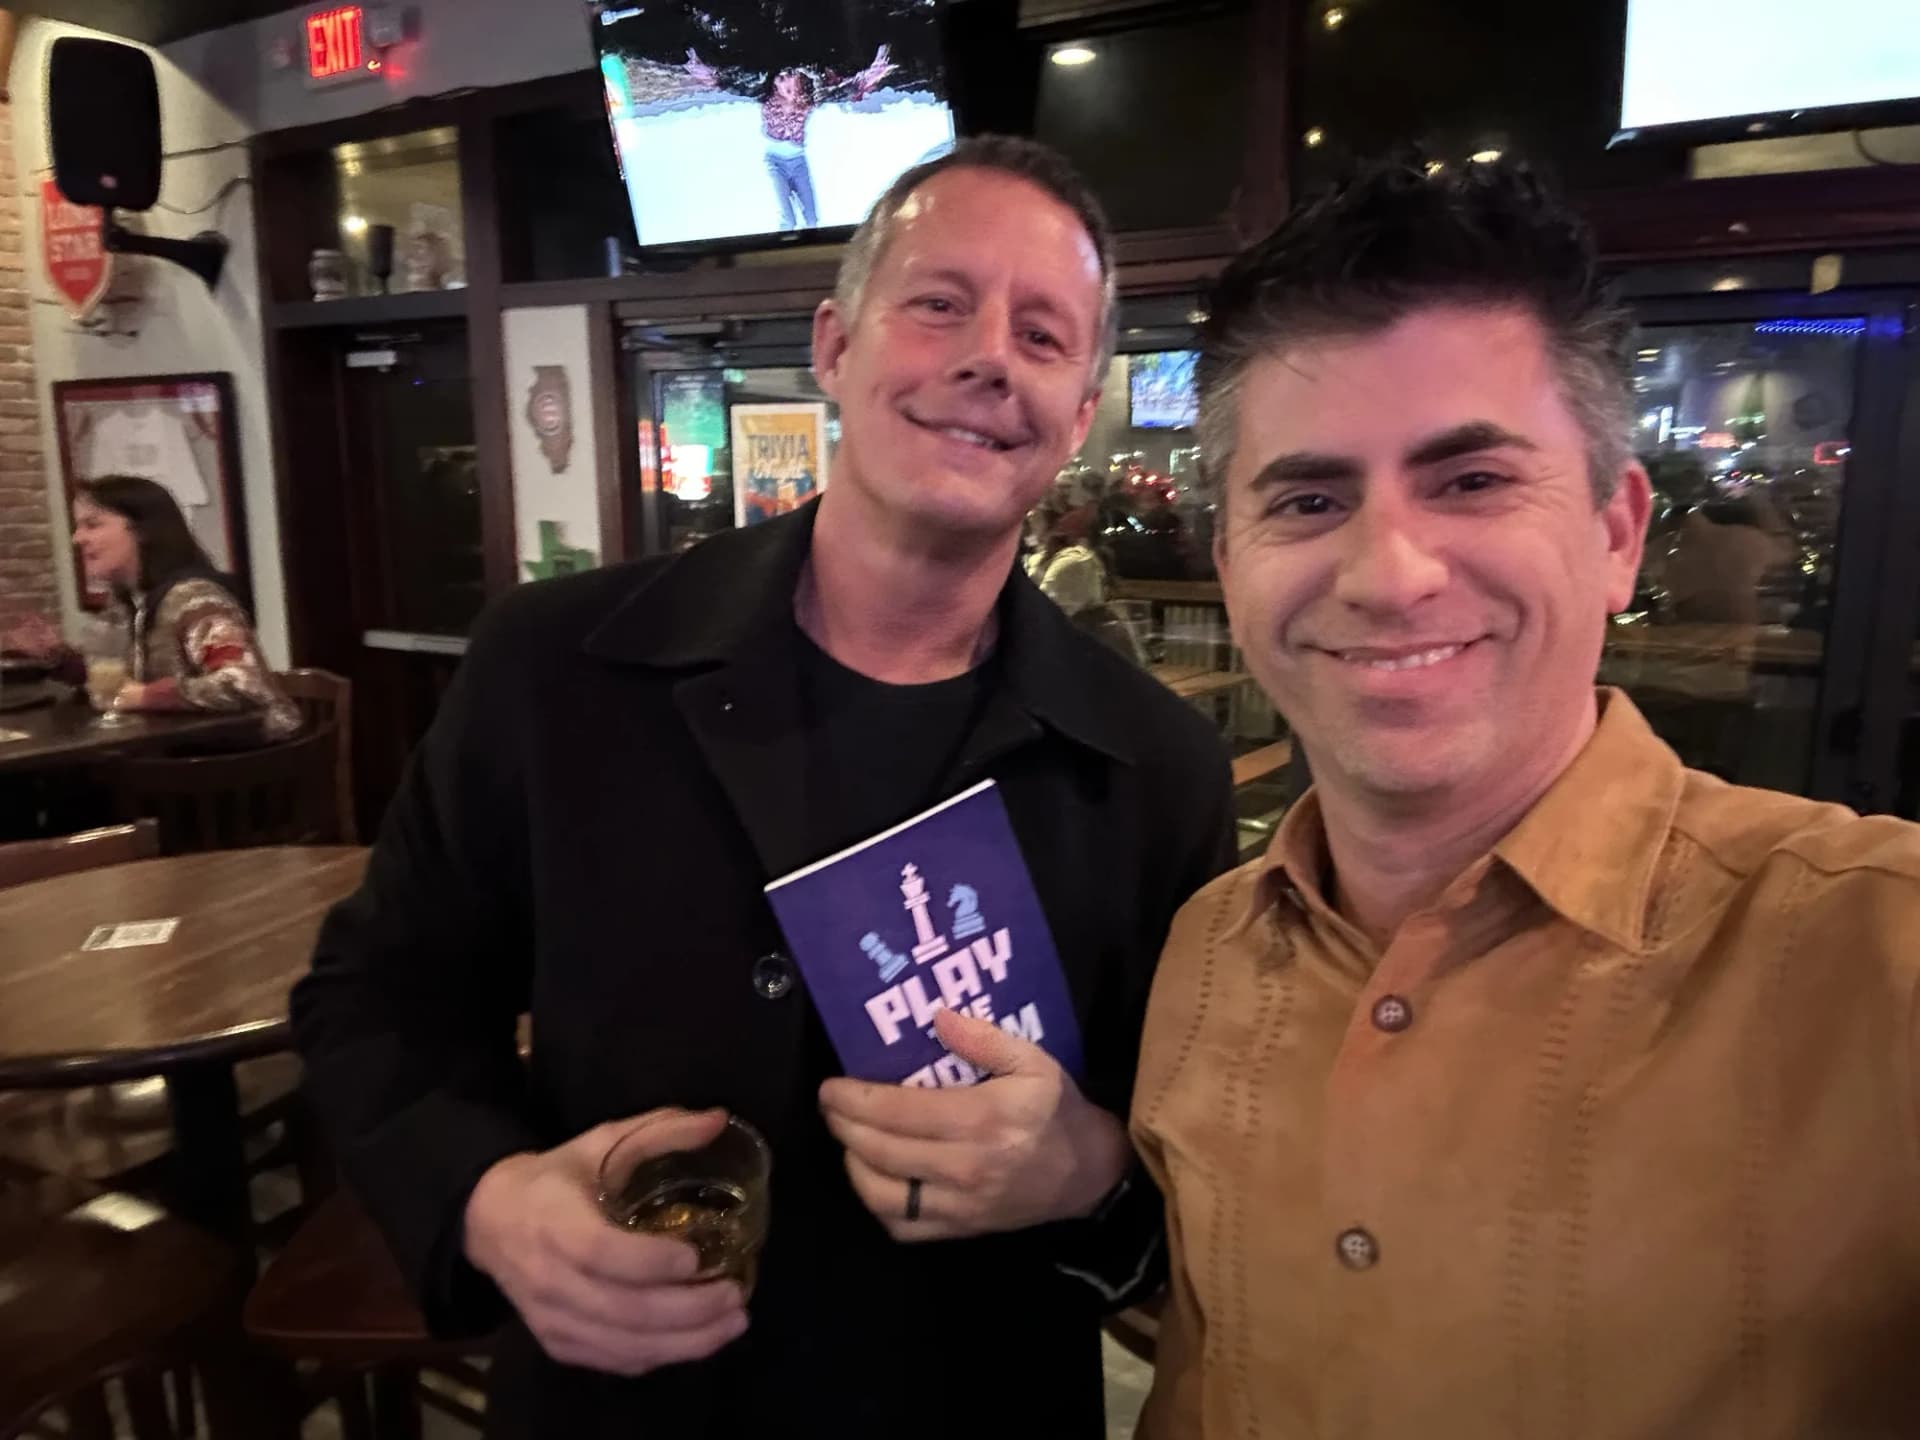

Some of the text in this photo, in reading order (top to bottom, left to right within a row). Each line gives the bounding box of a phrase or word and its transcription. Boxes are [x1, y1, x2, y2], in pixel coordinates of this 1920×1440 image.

[308, 9, 357, 77] EXIT
[747, 432, 809, 460] TRIVIA
[864, 927, 1012, 1046] PLAY
